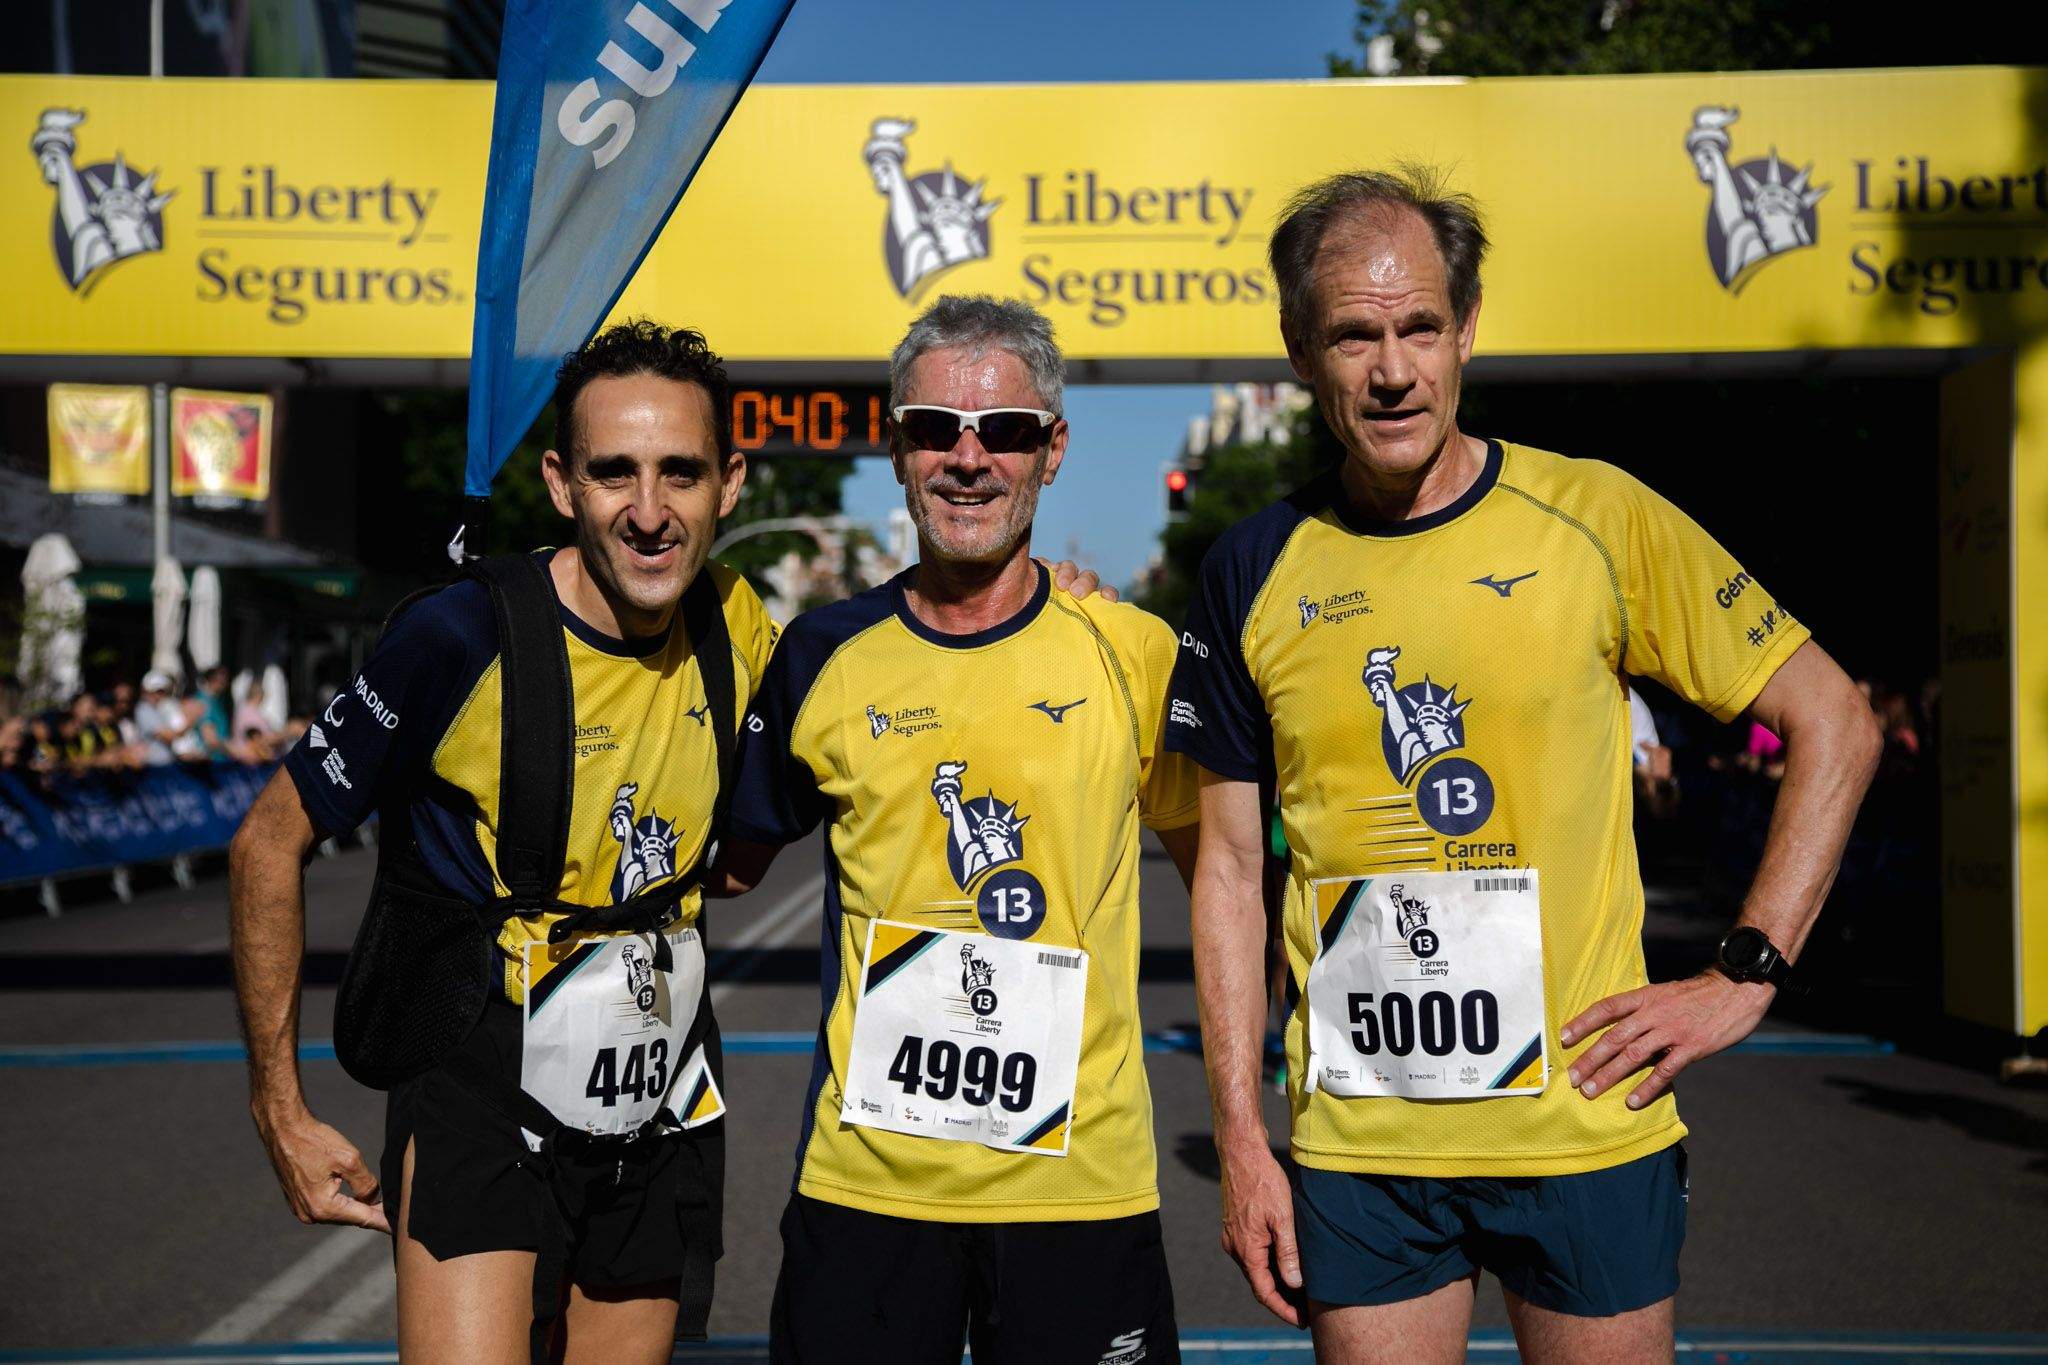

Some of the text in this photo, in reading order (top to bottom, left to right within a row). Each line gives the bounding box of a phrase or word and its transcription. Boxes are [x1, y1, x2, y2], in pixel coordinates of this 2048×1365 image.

[198, 165, 440, 244] Liberty
[1022, 169, 1254, 247] Liberty
[1324, 590, 1366, 609] Liberty
[355, 674, 399, 730] MADRID
[895, 705, 937, 722] Liberty
[1432, 777, 1478, 816] 13
[1444, 841, 1517, 859] Carrera
[991, 887, 1033, 924] 13
[1414, 935, 1435, 952] 13
[1419, 959, 1449, 968] Carrera
[1420, 967, 1449, 976] Liberty
[640, 990, 653, 1007] 13
[975, 994, 993, 1011] 13
[975, 1023, 1001, 1036] Liberty
[976, 1016, 1002, 1027] Carrera
[1346, 989, 1500, 1057] 5000
[585, 1038, 668, 1108] 443
[887, 1034, 1037, 1113] 4999
